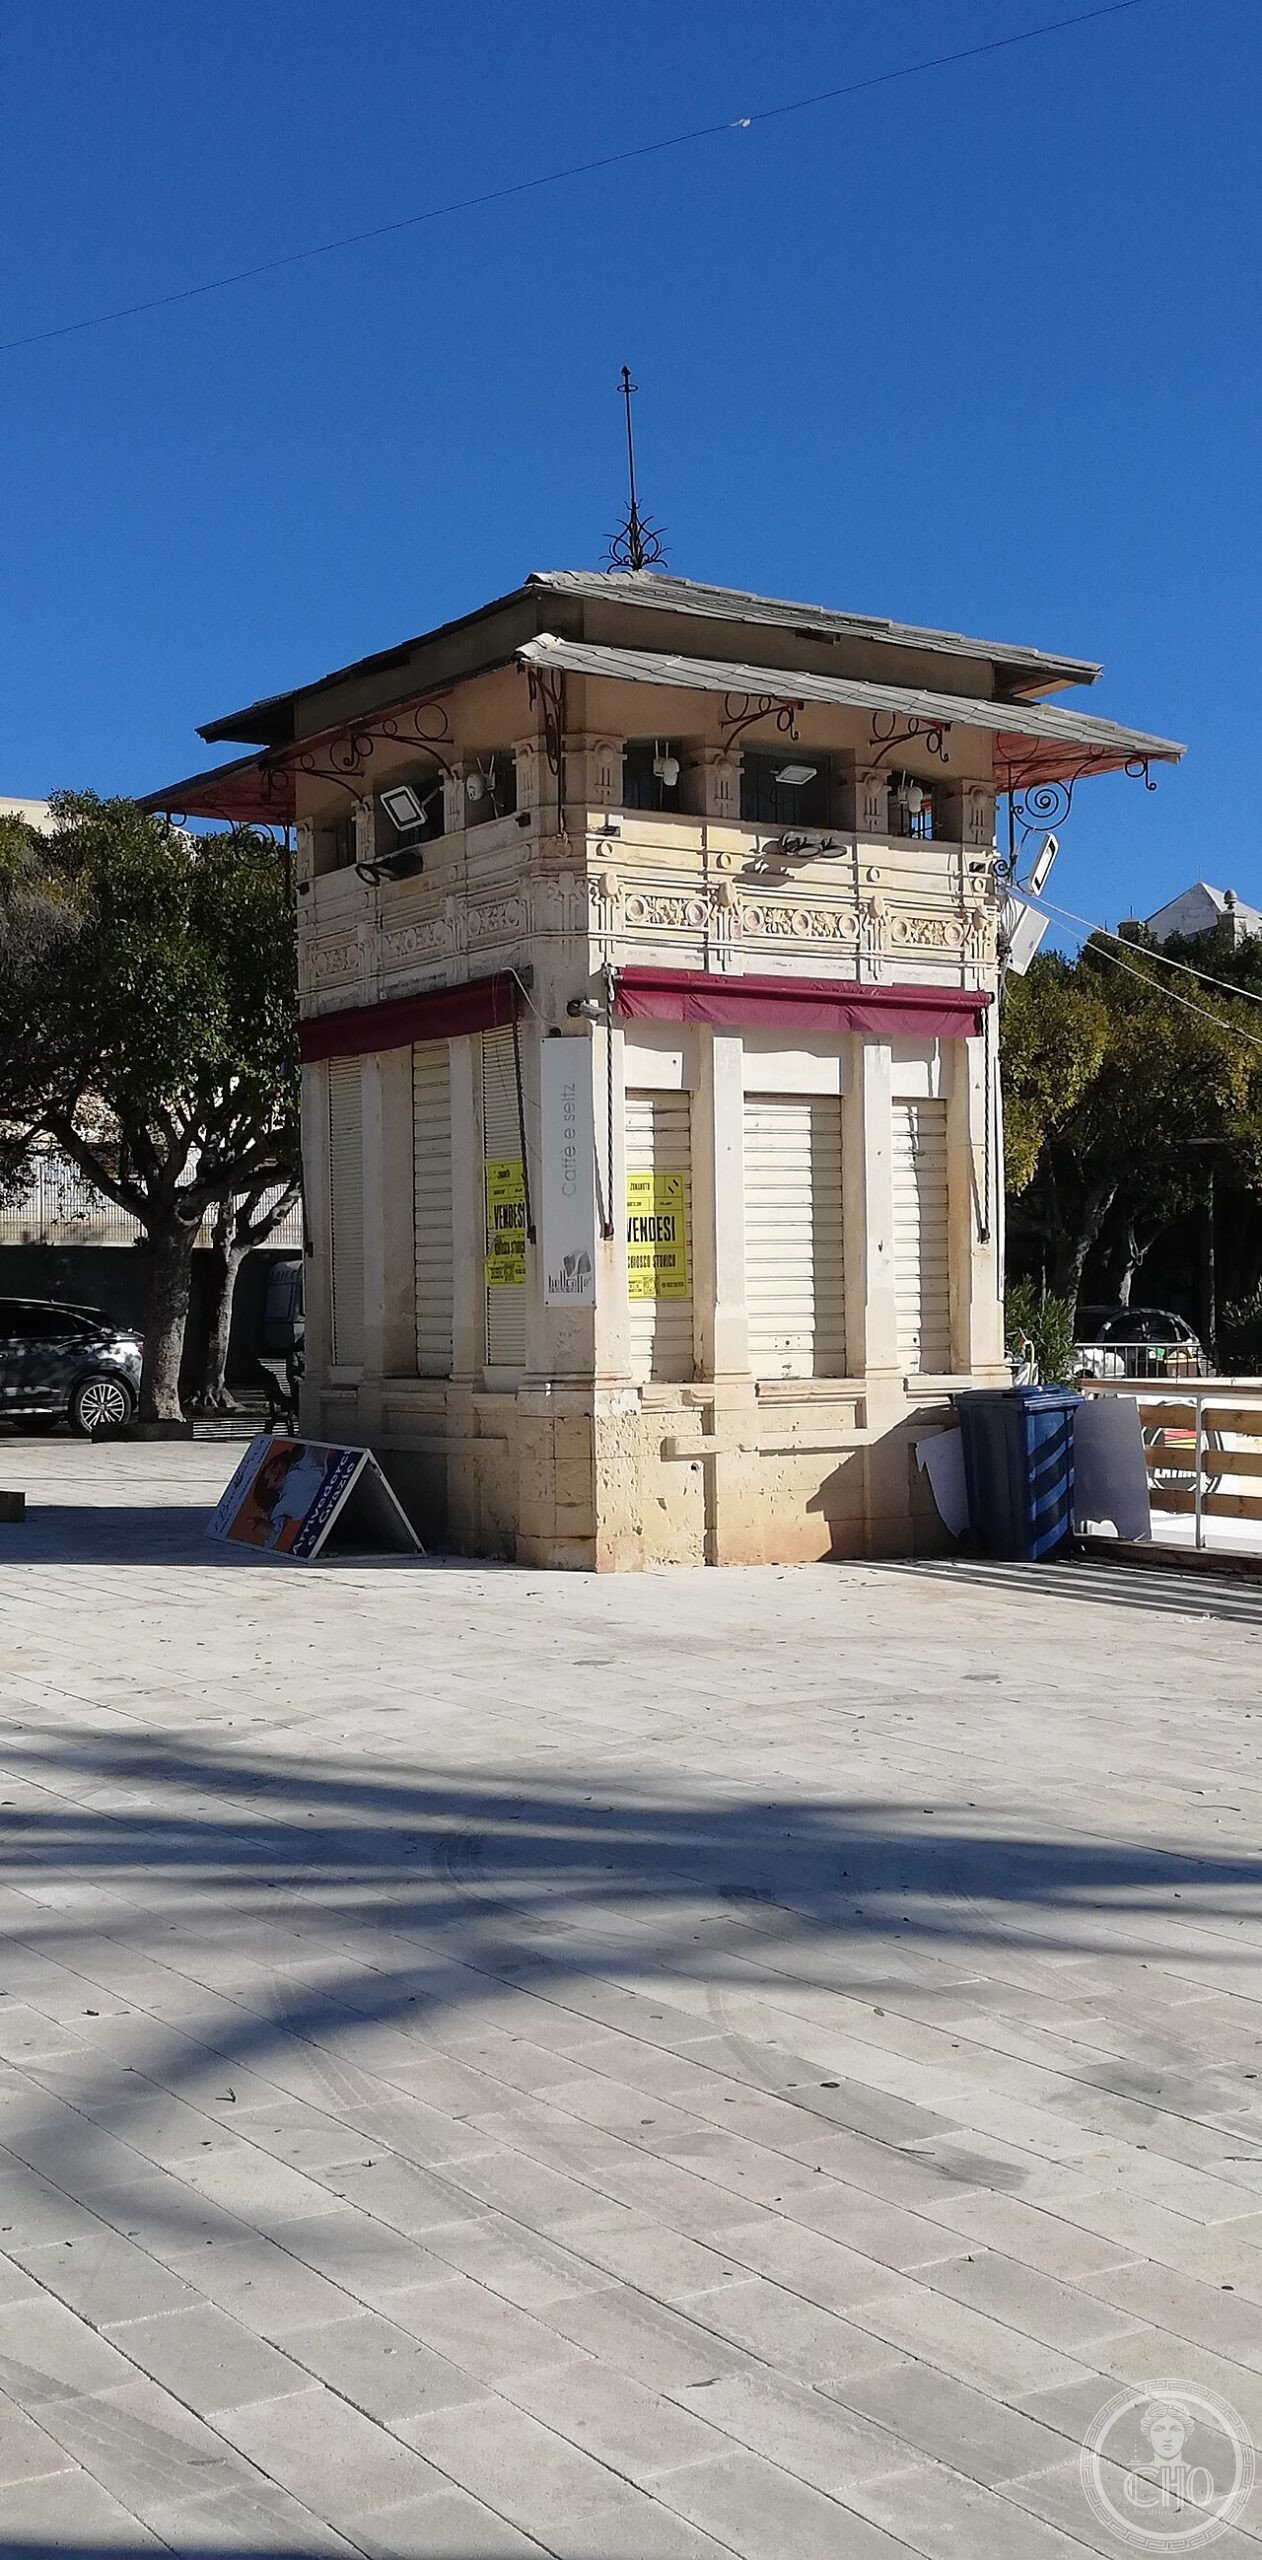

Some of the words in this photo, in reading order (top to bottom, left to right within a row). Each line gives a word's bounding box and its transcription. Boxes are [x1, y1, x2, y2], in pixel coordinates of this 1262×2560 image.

[560, 1083, 576, 1122] seltz
[563, 1127, 577, 1139] e
[560, 1146, 577, 1197] Caffè
[493, 1202, 526, 1230] VENDESI
[627, 1216, 676, 1243] VENDESI
[652, 1254, 676, 1268] STORICO
